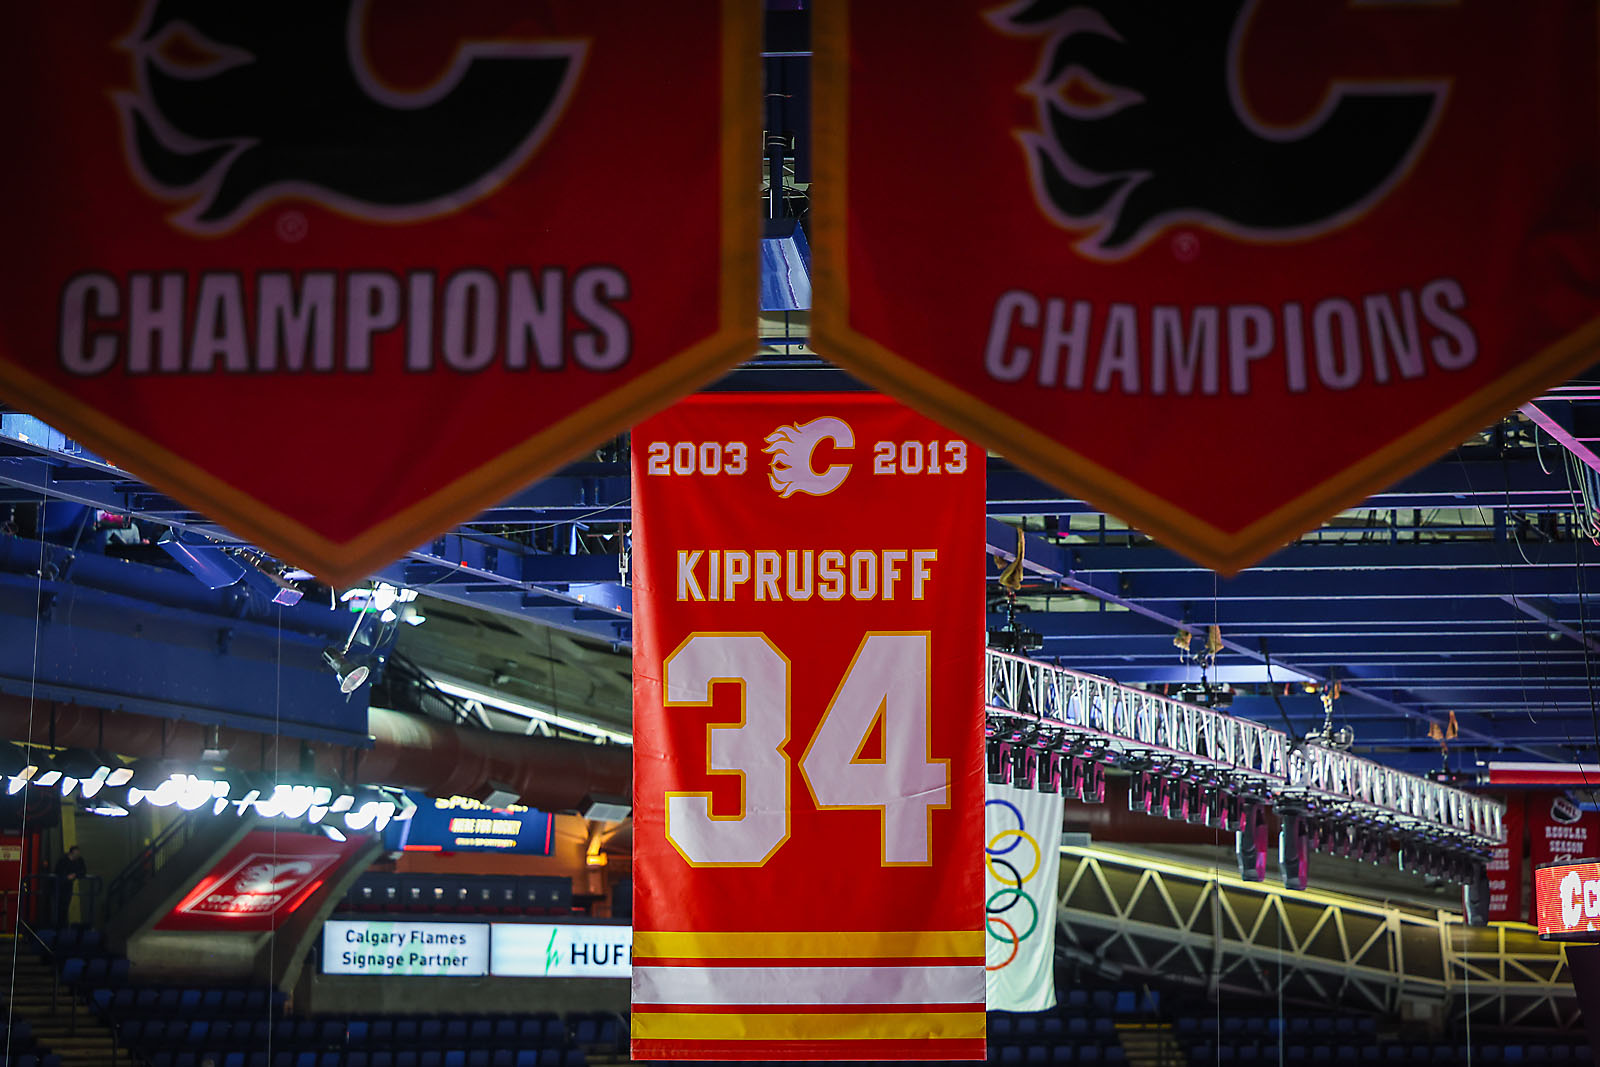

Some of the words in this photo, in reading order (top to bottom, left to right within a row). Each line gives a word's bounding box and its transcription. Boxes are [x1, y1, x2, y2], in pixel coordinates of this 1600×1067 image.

[59, 266, 632, 376] CHAMPIONS
[985, 279, 1478, 395] CHAMPIONS
[647, 440, 749, 477] 2003
[873, 439, 968, 475] 2013
[676, 548, 938, 602] KIPRUSOFF
[663, 630, 951, 868] 34
[1549, 840, 1584, 854] SEASON
[346, 929, 406, 946] Calgary
[410, 930, 467, 945] Flames
[571, 943, 632, 965] HUF
[342, 951, 405, 969] Signage
[409, 953, 468, 967] Partner
